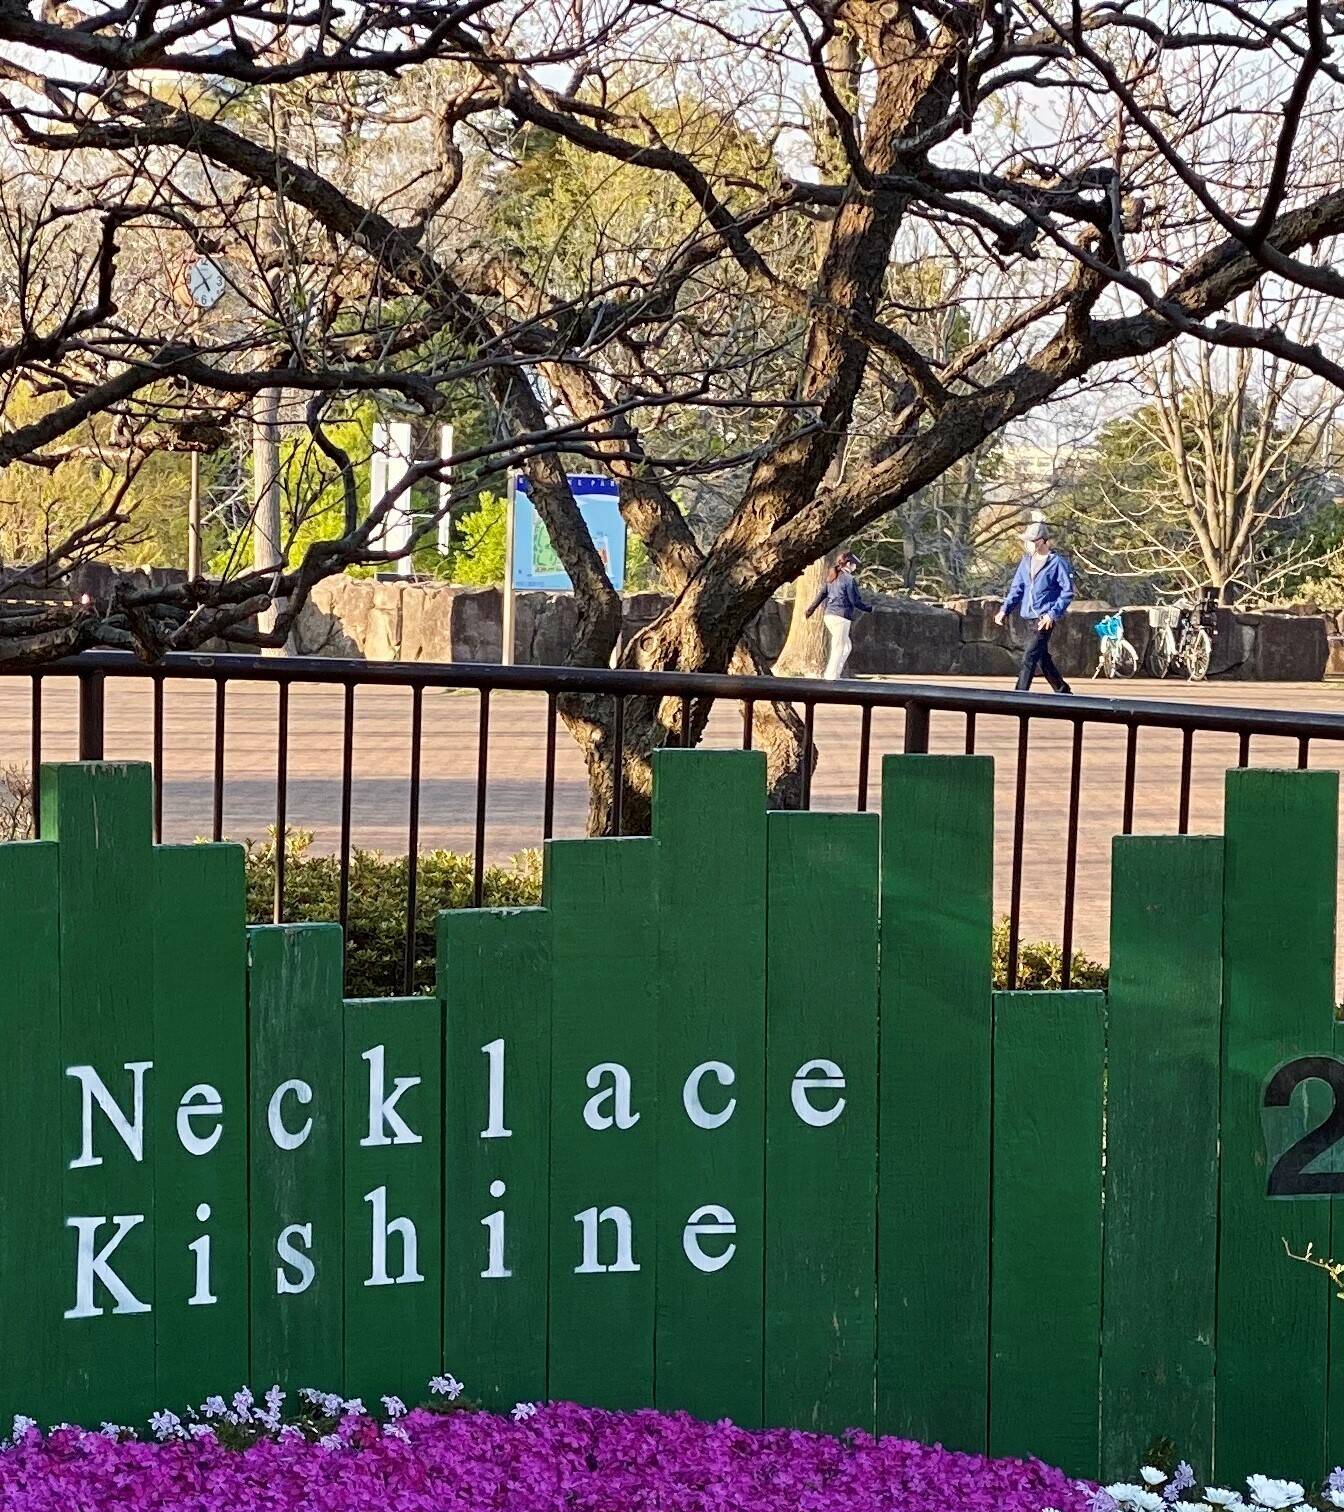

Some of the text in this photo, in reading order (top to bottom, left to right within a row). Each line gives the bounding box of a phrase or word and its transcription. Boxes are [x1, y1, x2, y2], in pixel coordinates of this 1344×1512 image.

[216, 275, 223, 287] 3
[65, 1039, 846, 1169] Necklace
[63, 1180, 737, 1319] Kishine
